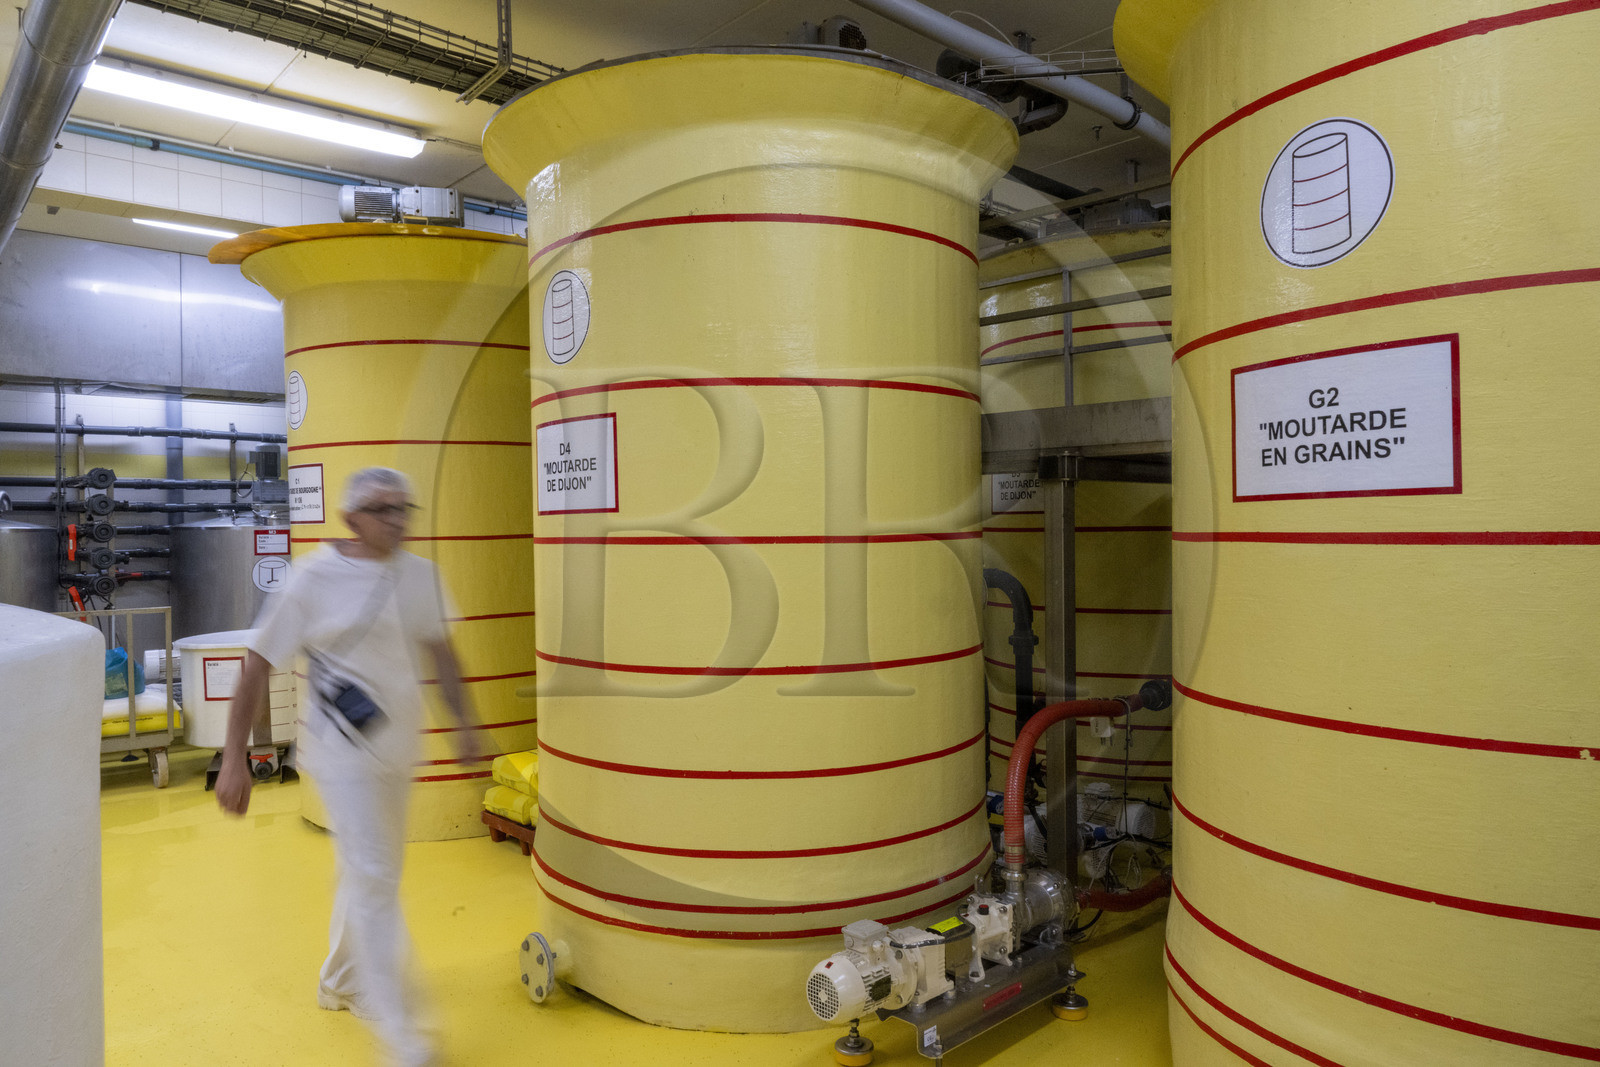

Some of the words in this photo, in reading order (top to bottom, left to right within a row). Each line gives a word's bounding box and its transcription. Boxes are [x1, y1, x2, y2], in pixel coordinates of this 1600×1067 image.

[1308, 387, 1339, 409] G2
[1259, 407, 1407, 441] "MOUTARDE
[559, 442, 571, 456] D4
[1261, 446, 1287, 467] EN
[1294, 436, 1405, 464] GRAINS"
[543, 457, 597, 475] "MOUTARDE
[547, 479, 557, 492] DE
[558, 476, 592, 491] DIJON"
[998, 478, 1040, 489] "MOUTARDE
[1000, 492, 1008, 501] DE
[1010, 490, 1036, 500] DIJON"
